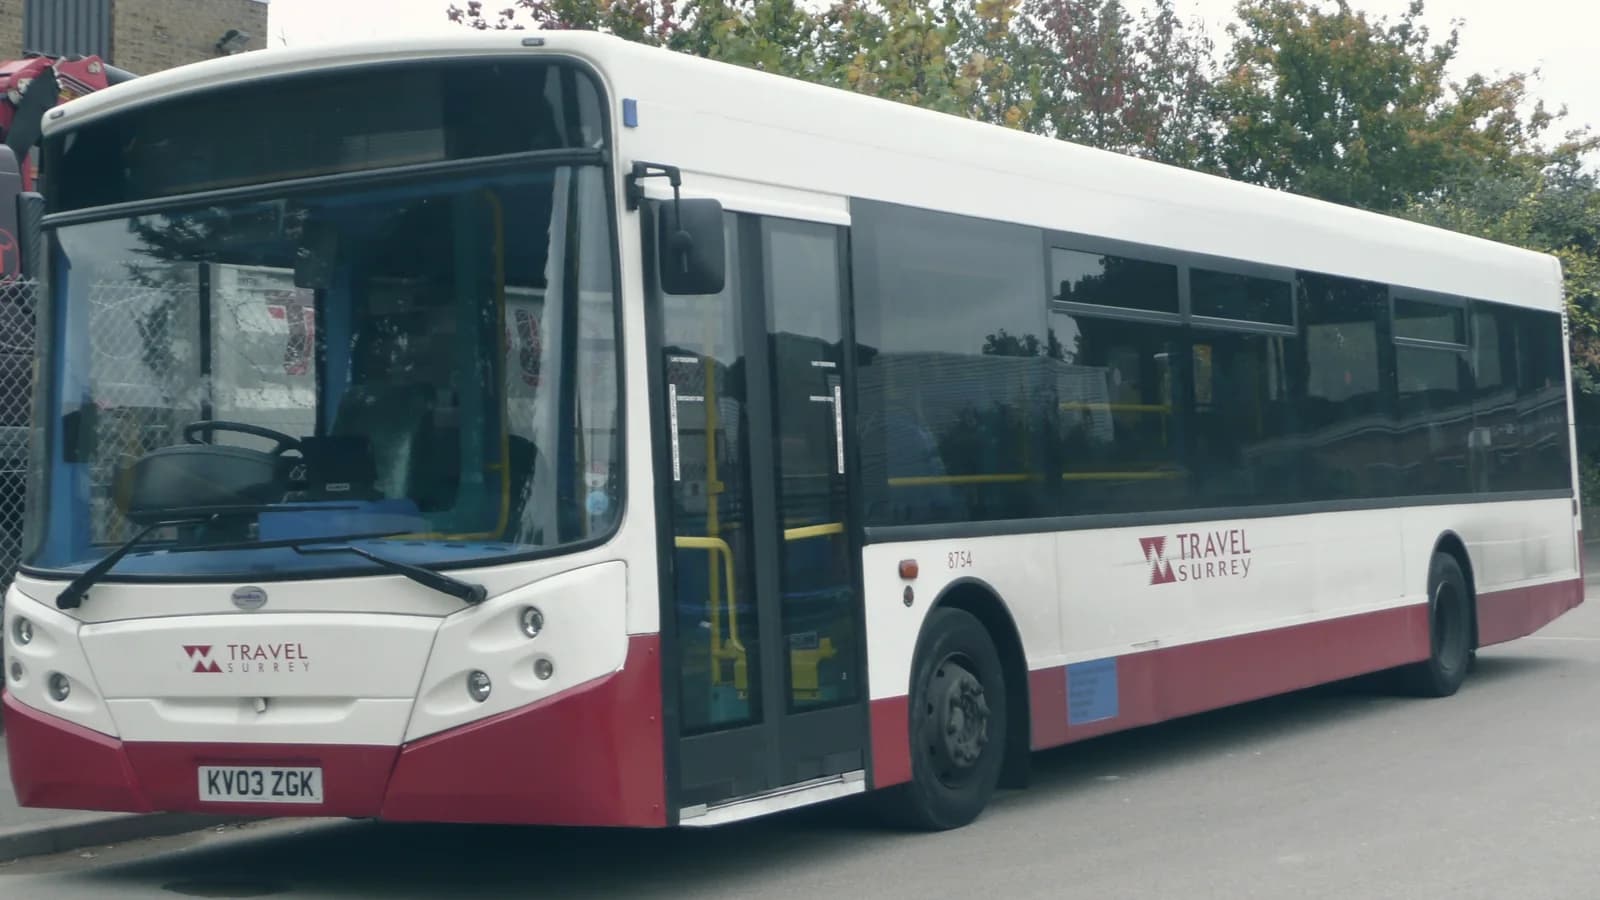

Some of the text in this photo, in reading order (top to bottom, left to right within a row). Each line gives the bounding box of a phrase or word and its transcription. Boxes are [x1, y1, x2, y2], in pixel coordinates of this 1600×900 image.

[1176, 529, 1251, 560] TRAVEL
[947, 550, 973, 569] 8754
[1178, 558, 1251, 582] SURREY
[227, 643, 308, 660] TRAVEL
[227, 661, 310, 673] SURREY
[207, 770, 314, 796] KV03 ZGK
